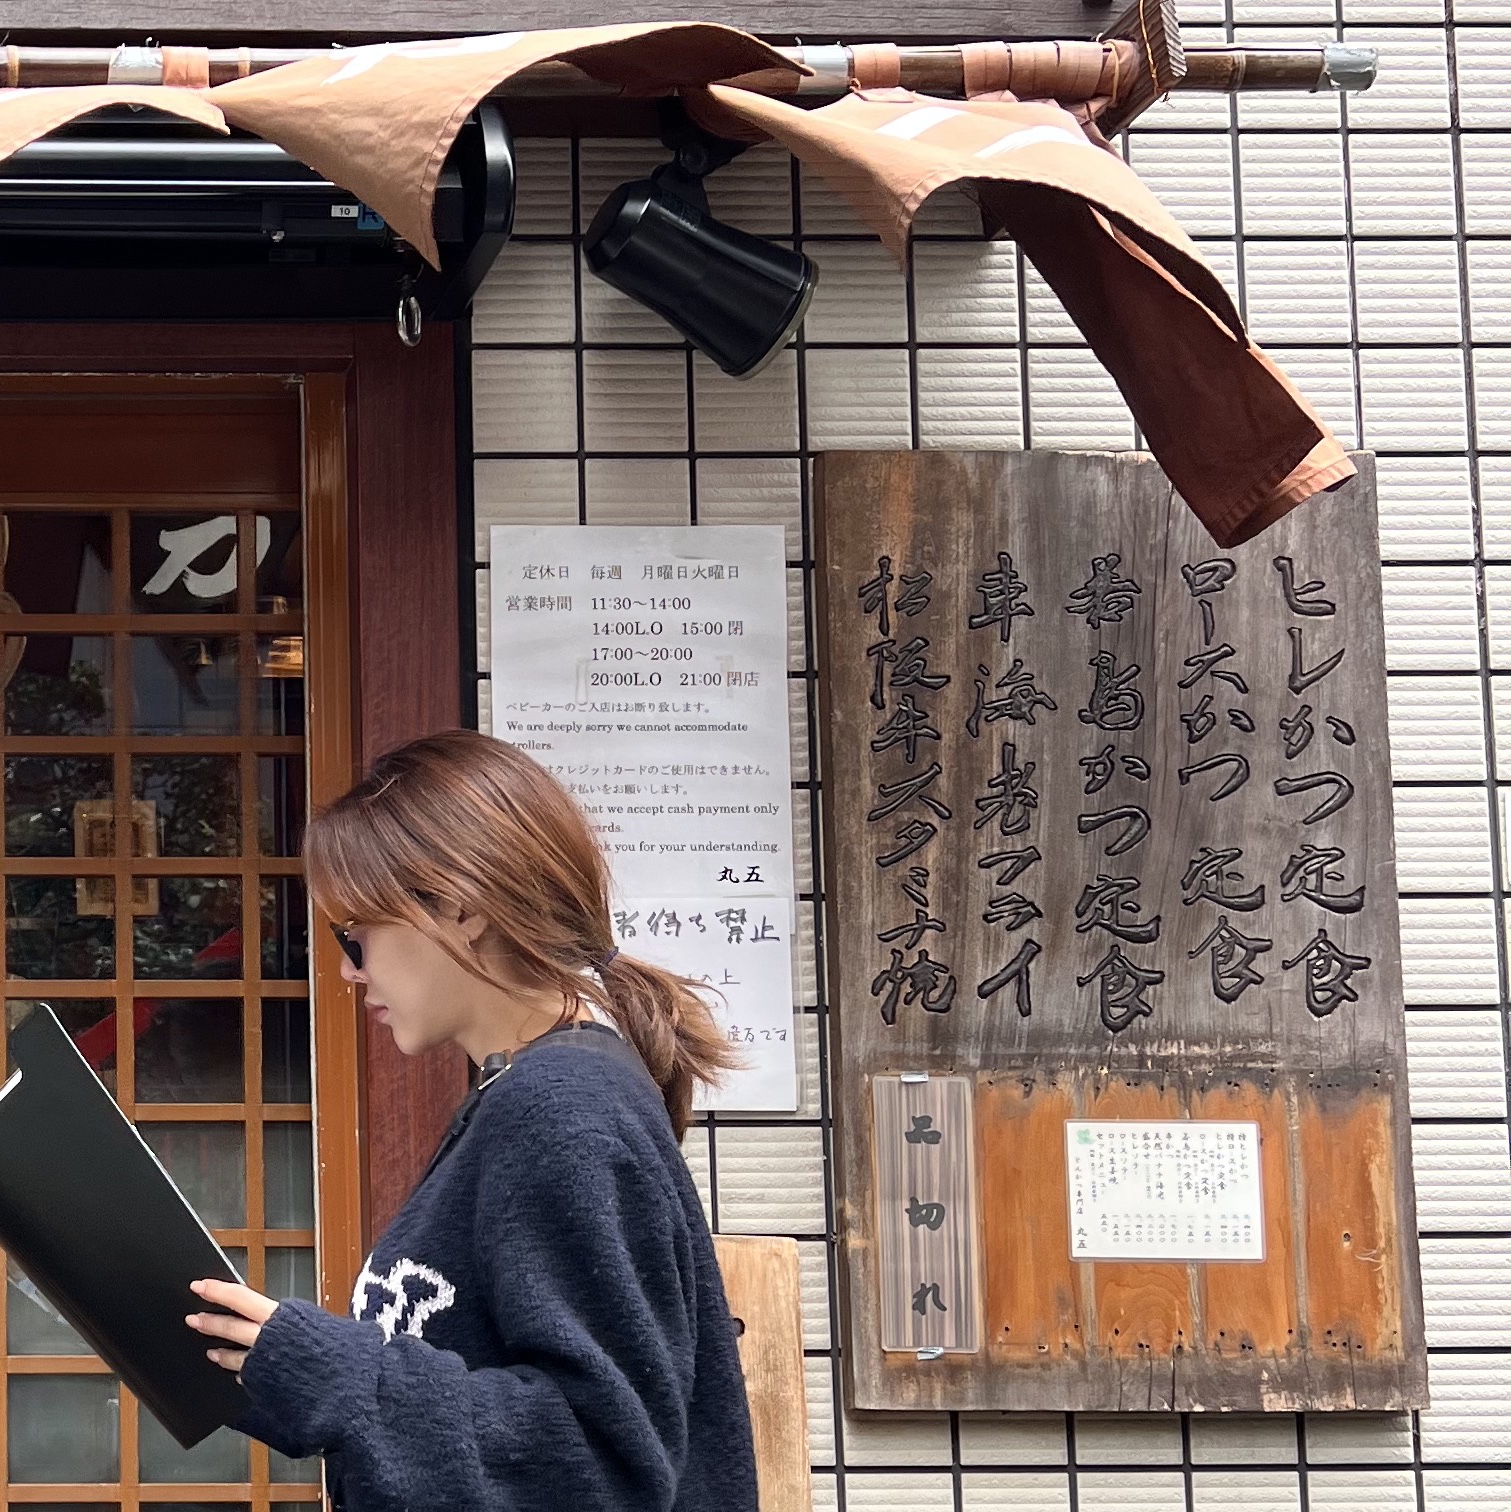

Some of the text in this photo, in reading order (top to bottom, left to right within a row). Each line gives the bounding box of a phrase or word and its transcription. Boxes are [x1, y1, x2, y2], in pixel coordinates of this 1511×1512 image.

[522, 564, 740, 581] 定休日 毎週 月曜日火曜日
[505, 594, 573, 612] 営業時間
[681, 621, 724, 636] 15:00
[728, 620, 744, 636] 閉
[679, 672, 723, 687] 21:00
[726, 671, 760, 688] 閉店
[506, 720, 749, 734] We are deeply sorry we cannot accommodate
[510, 739, 556, 751] trollers.
[858, 556, 956, 1026] 松阪牛スタミナ焼
[965, 552, 1058, 1018] 車海老フライ
[1066, 553, 1165, 1034] 若鳥かつ定食
[1273, 556, 1372, 1019] ヒレかつ定食
[606, 805, 624, 814] we
[626, 803, 665, 817] accept
[667, 802, 695, 814] cash
[697, 803, 751, 817] payment
[753, 802, 780, 816] only
[590, 821, 624, 833] ards.
[614, 843, 636, 854] you
[639, 840, 657, 852] for
[658, 843, 687, 854] your
[689, 840, 781, 854] understanding.
[716, 865, 765, 884] 丸五
[904, 1115, 948, 1316] 品切れ
